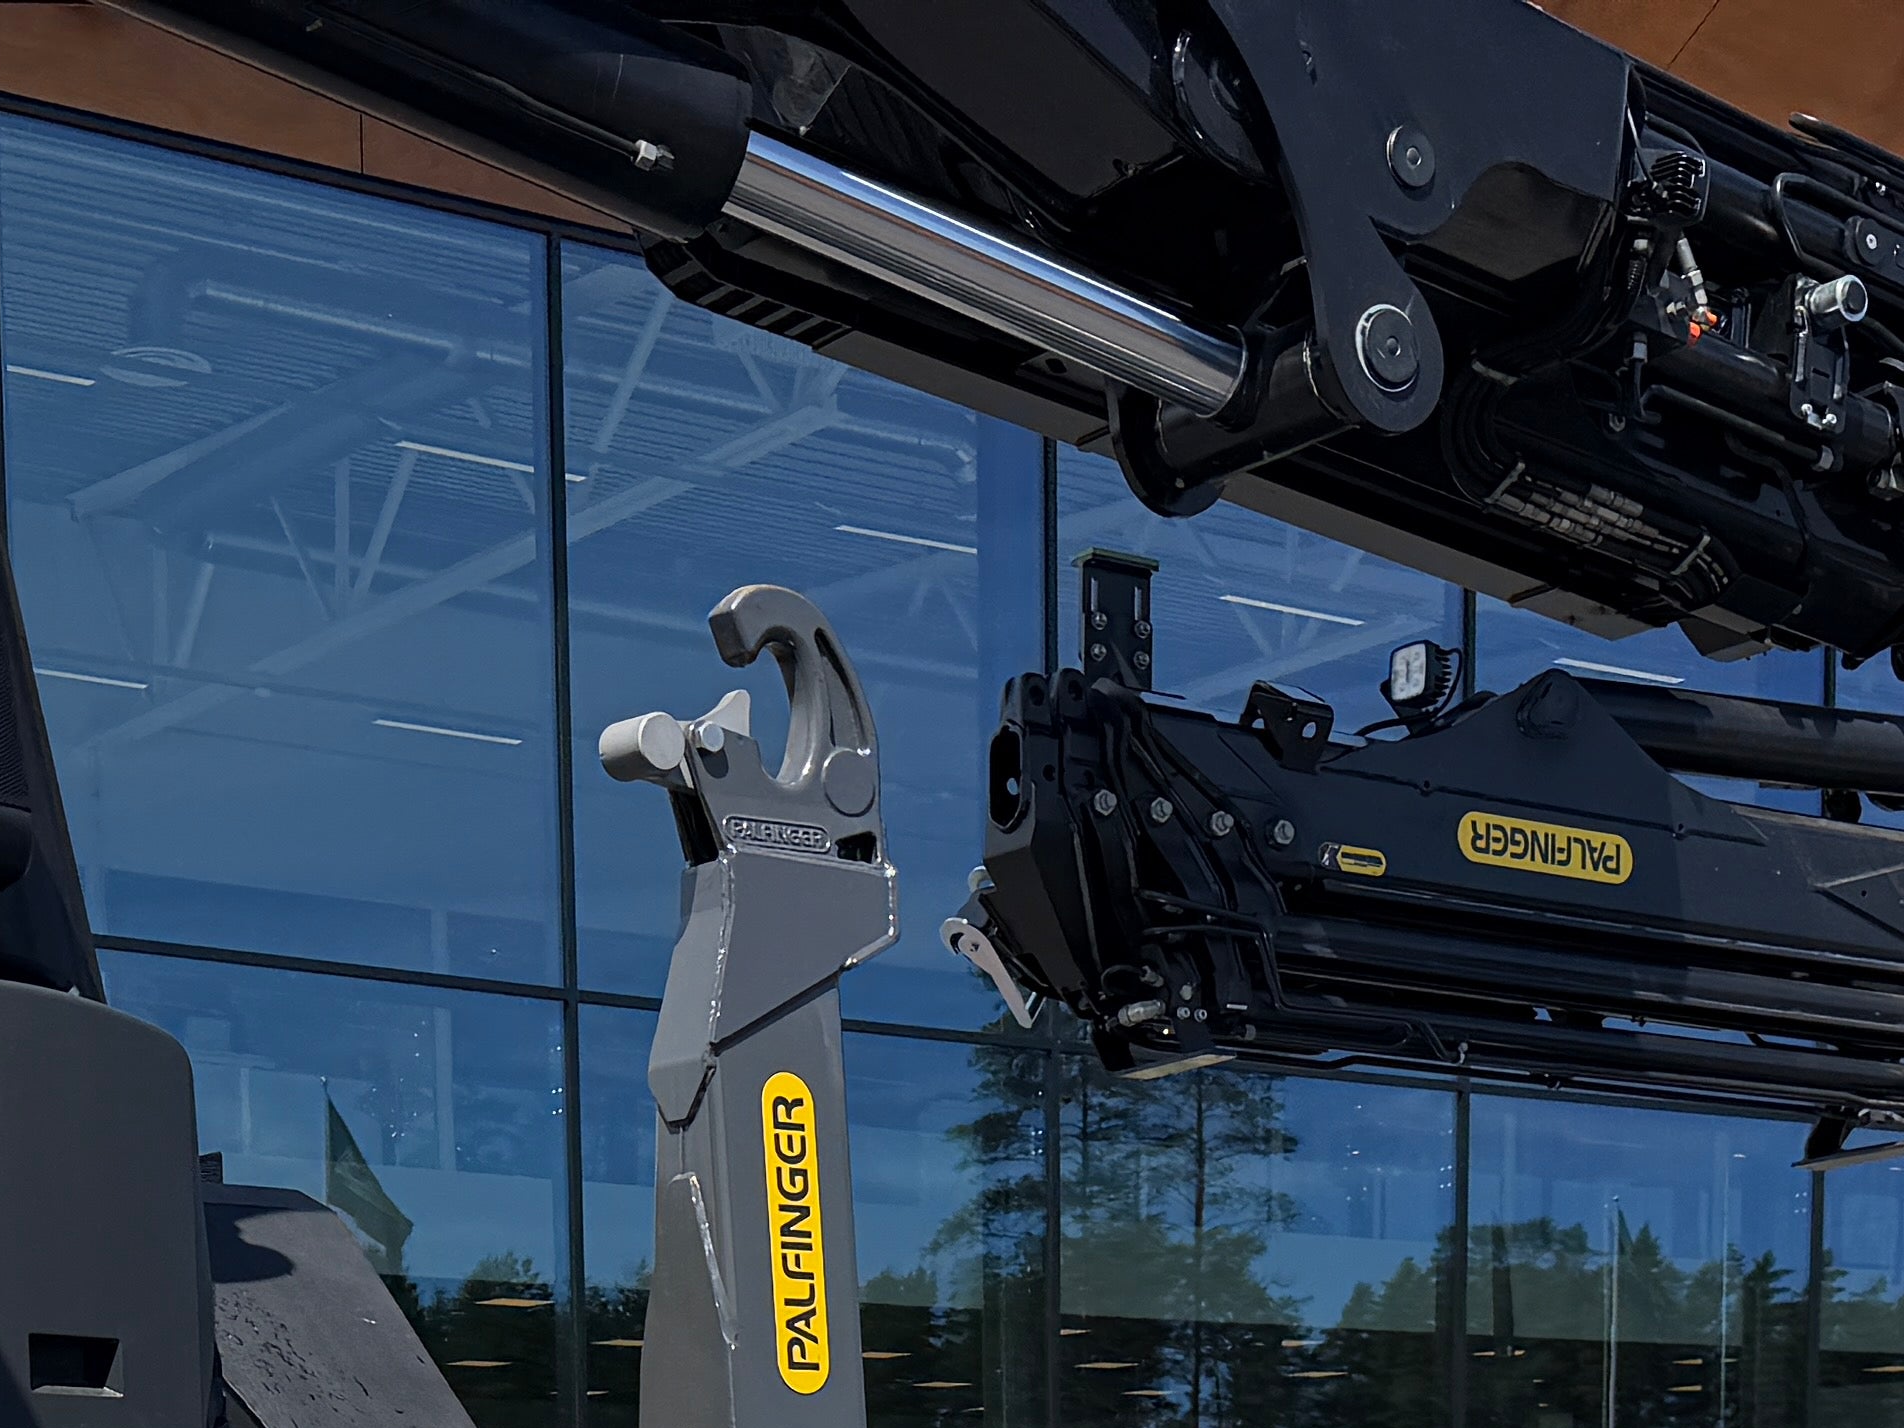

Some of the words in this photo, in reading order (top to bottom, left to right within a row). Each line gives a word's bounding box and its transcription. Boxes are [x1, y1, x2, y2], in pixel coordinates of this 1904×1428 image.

[730, 819, 823, 849] PALFINGER
[1470, 819, 1621, 876] PALFINGER
[772, 1095, 821, 1372] PALFINGER
